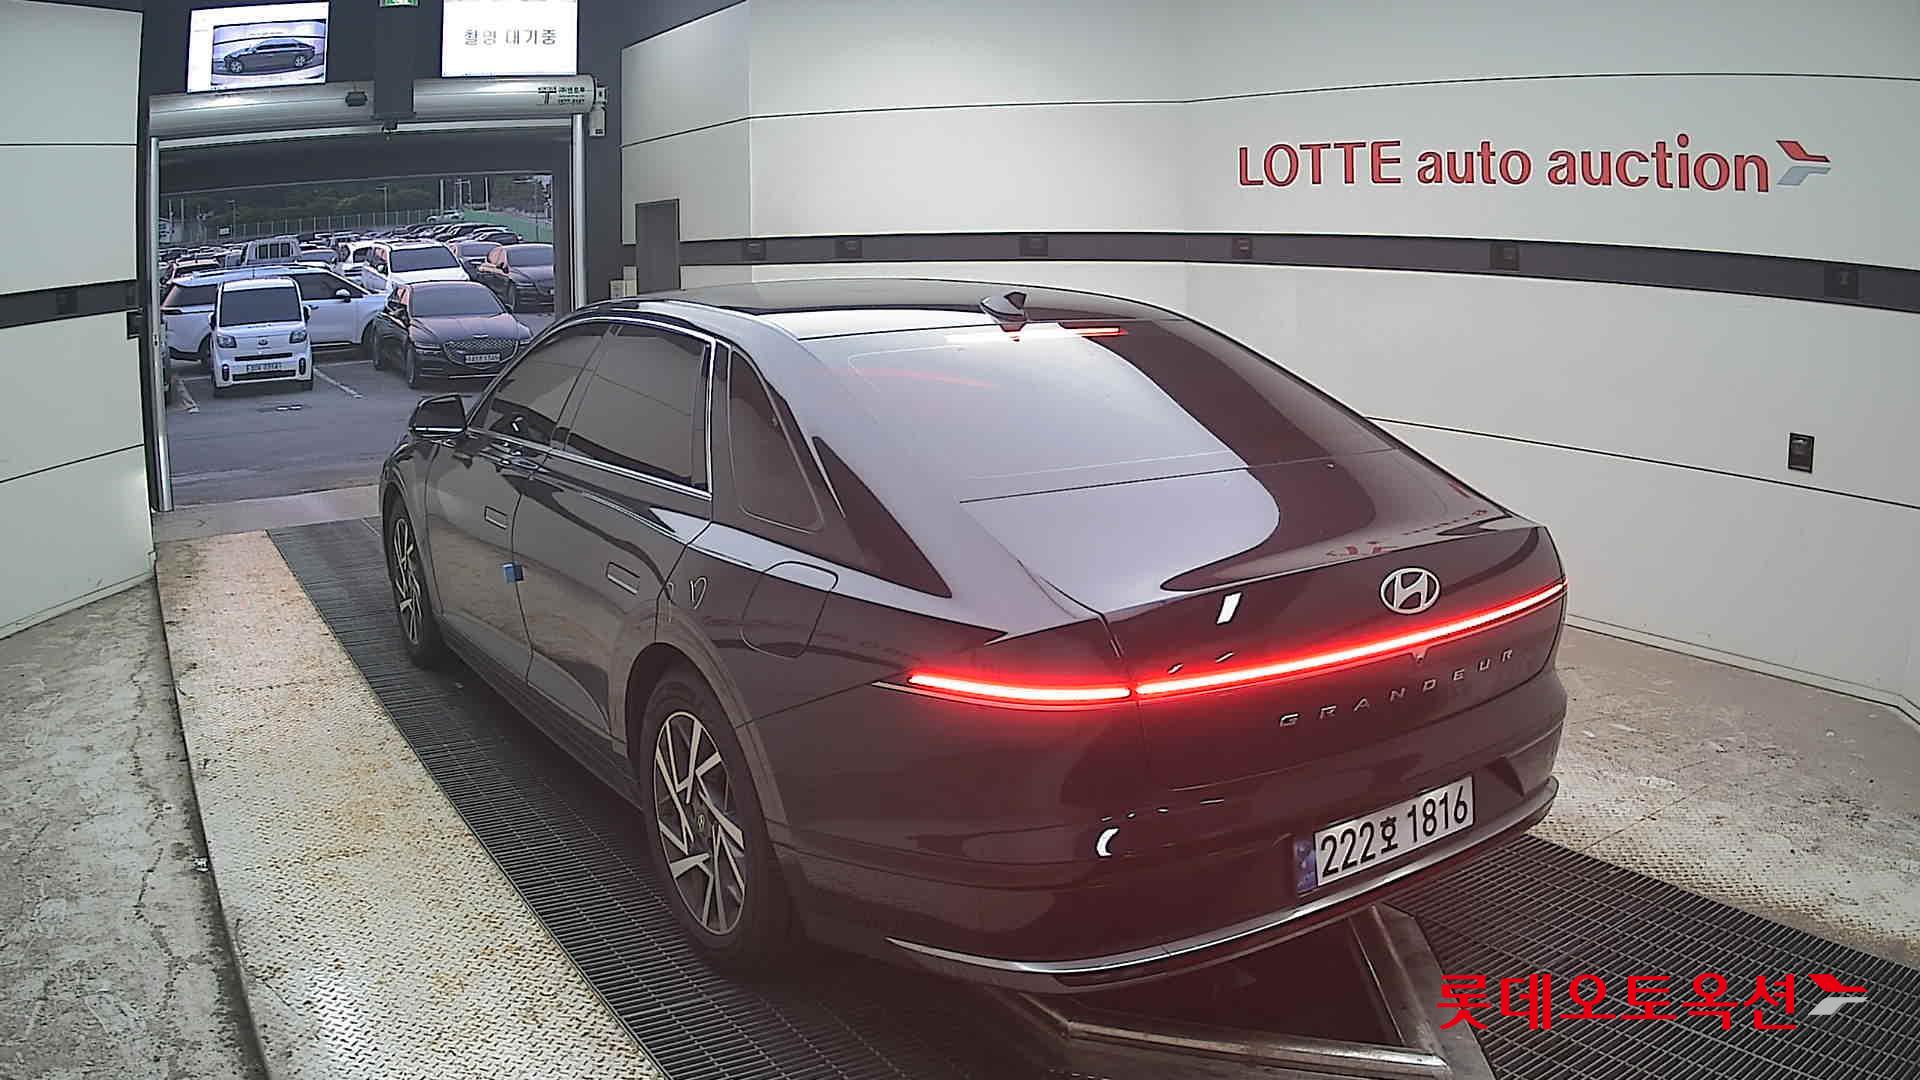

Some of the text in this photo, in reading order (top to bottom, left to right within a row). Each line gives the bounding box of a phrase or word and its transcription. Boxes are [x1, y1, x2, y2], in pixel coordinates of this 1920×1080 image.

[505, 29, 557, 46] 대기중
[1238, 133, 1770, 193] LOTTE auto auction
[1279, 649, 1513, 728] GRANDEUR
[1320, 784, 1469, 878] 222호 1816
